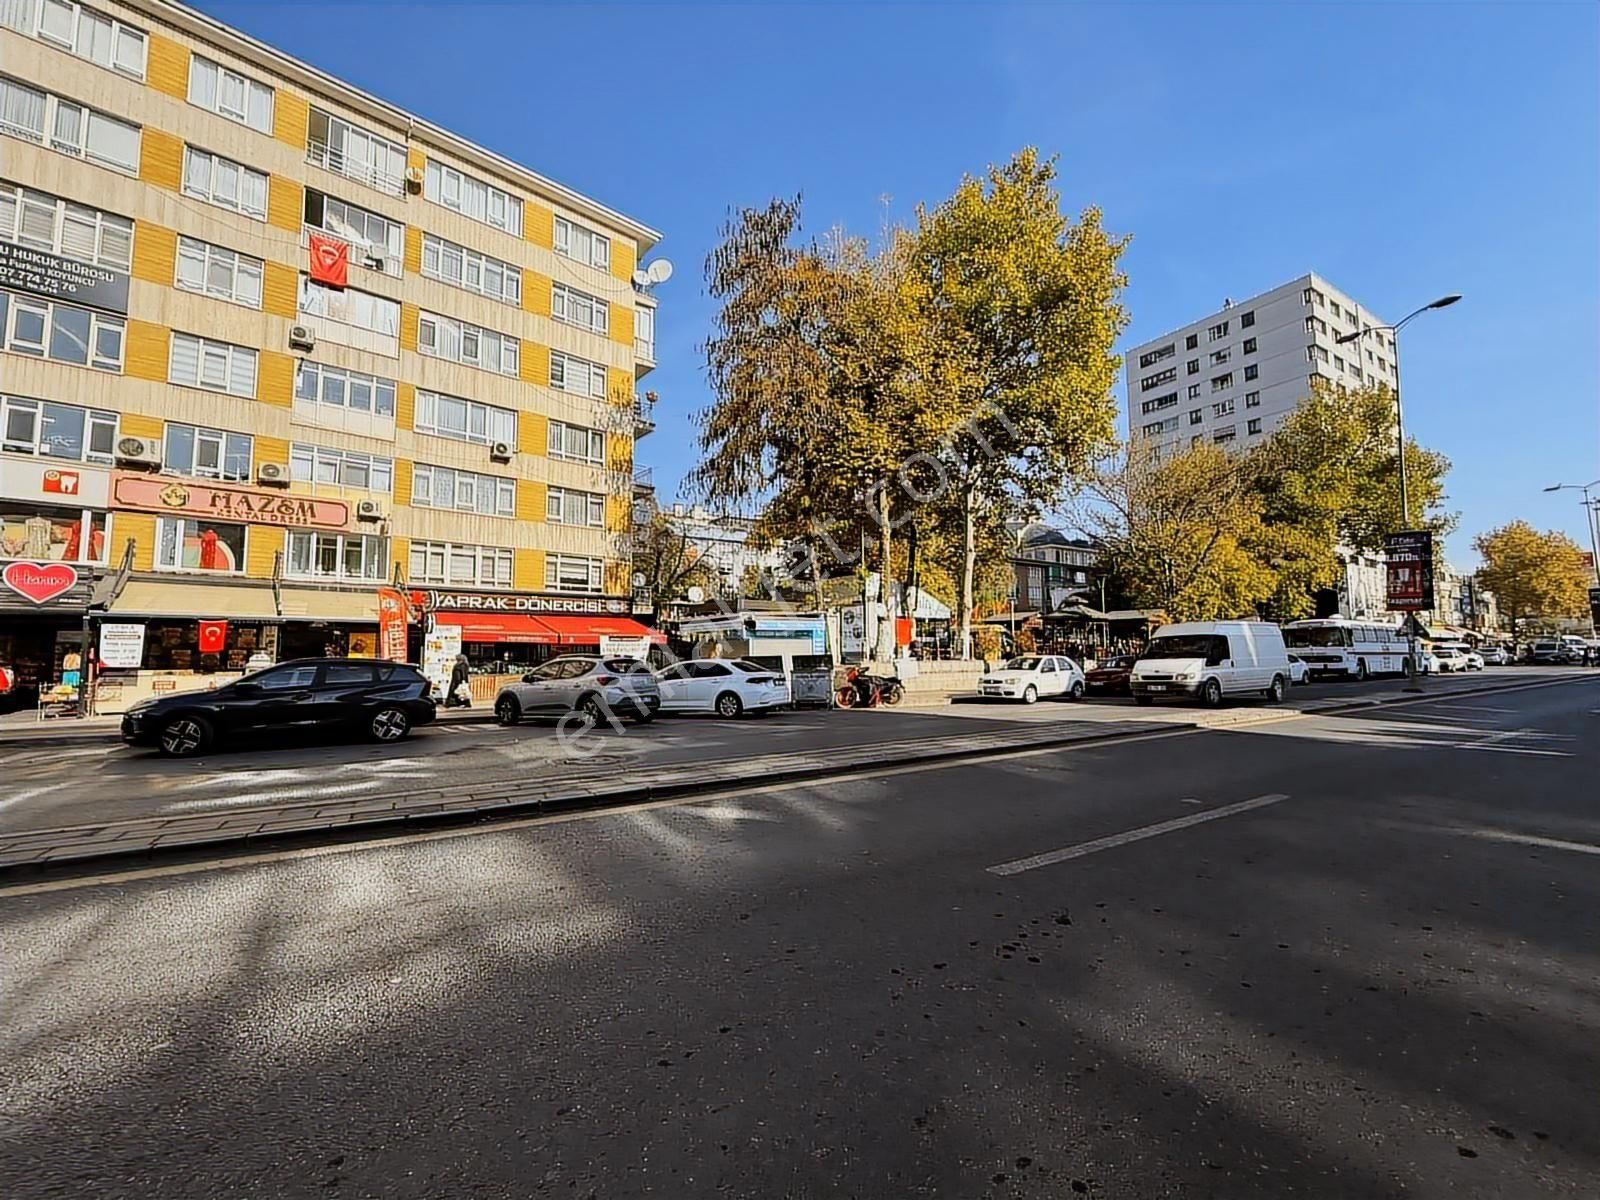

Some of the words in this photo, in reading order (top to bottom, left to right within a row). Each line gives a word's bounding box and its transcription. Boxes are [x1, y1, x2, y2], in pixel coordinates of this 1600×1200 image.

[9, 258, 45, 275] Furkan
[47, 268, 96, 288] KOYUNCU
[13, 248, 60, 269] HUKUK
[62, 261, 115, 283] BÜROSU
[18, 270, 41, 284] 774
[43, 276, 59, 289] 75
[61, 281, 77, 293] 76
[436, 594, 509, 611] YAPRAK
